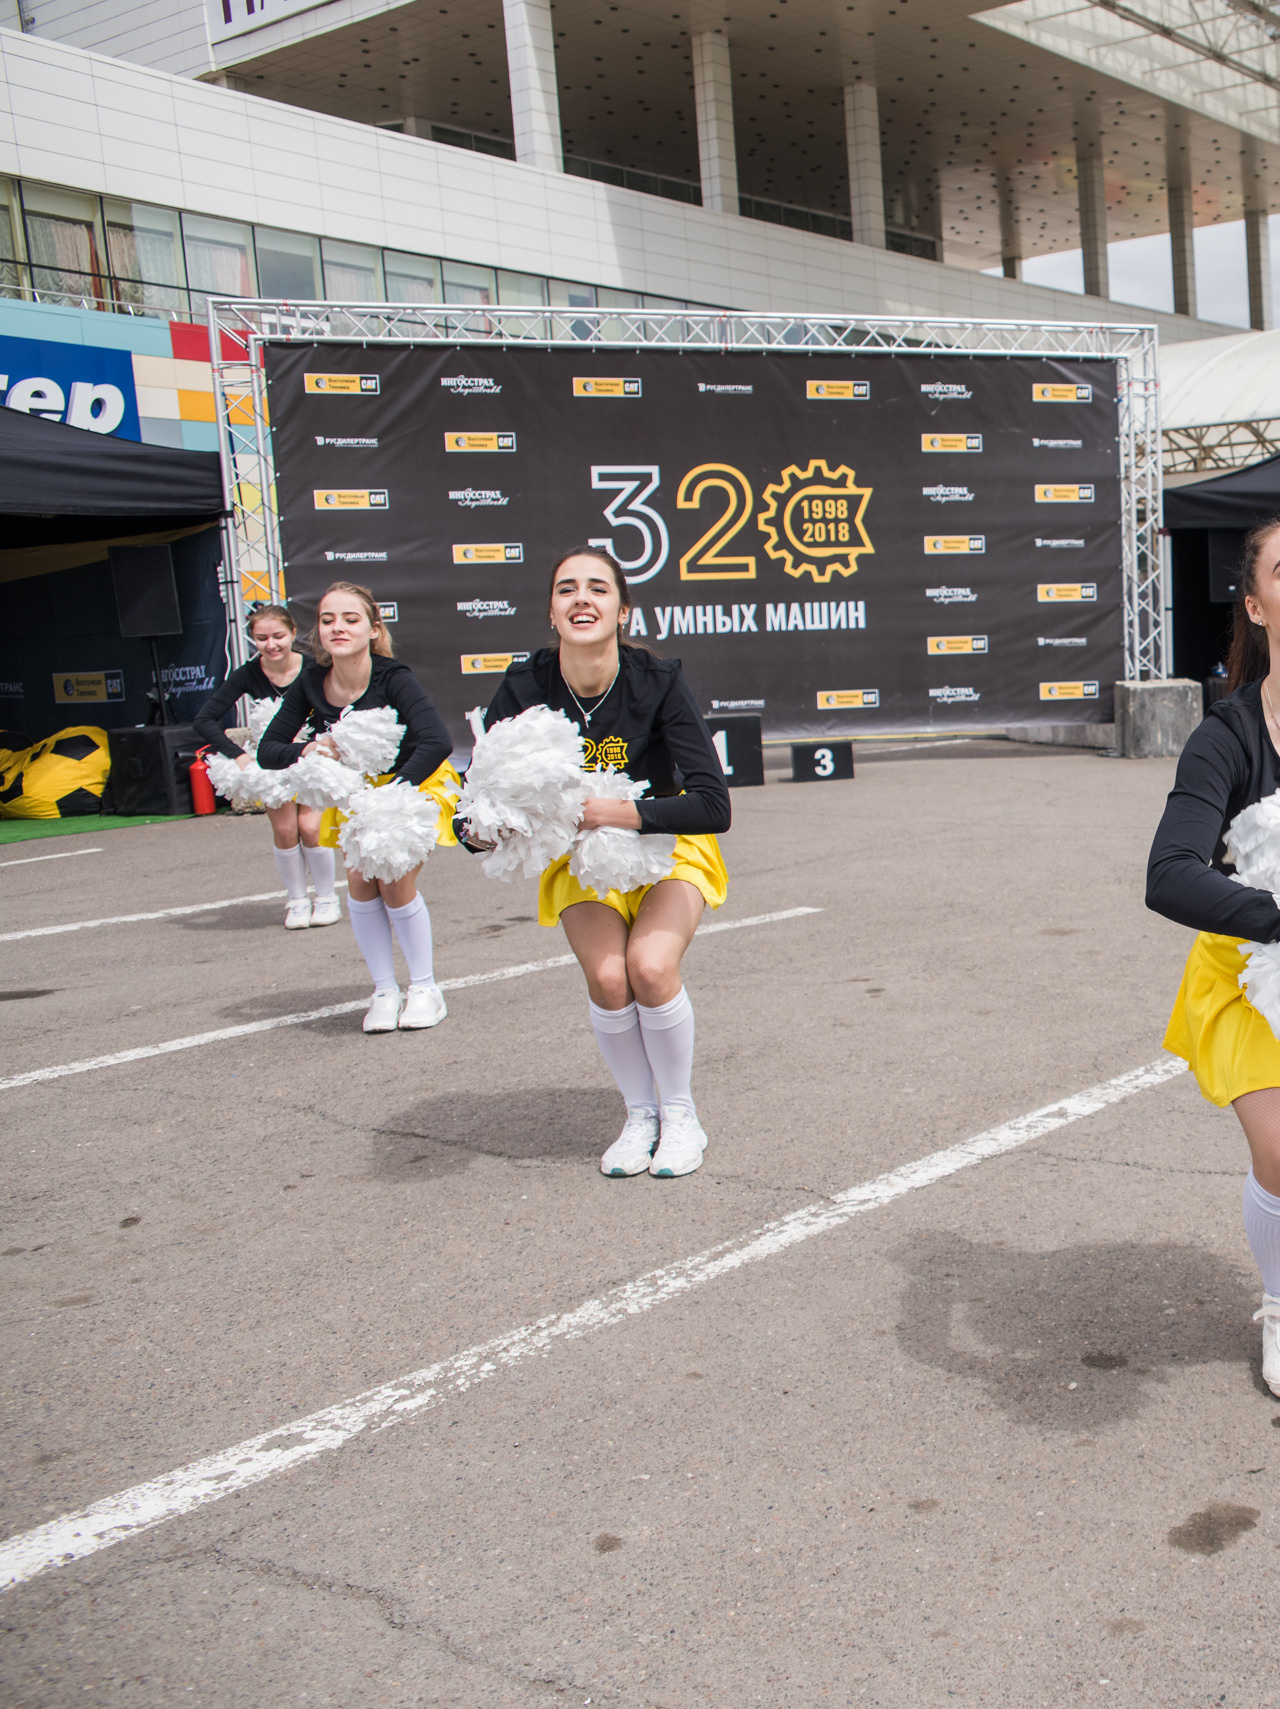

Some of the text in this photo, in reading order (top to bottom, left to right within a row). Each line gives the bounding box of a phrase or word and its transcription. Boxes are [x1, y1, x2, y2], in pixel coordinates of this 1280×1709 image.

[360, 379, 377, 390] CAT
[441, 377, 494, 387] ИНГОССТРАХ
[624, 383, 639, 392] CAT
[498, 438, 514, 447] CAT
[369, 494, 385, 504] CAT
[449, 490, 501, 500] ИНГОССТРАХ
[801, 499, 848, 519] 1998
[803, 522, 849, 542] 2018
[505, 548, 520, 557] CAT
[457, 601, 509, 611] ИНГОССТРАХ
[654, 604, 758, 640] УМНЫХ
[766, 601, 866, 631] МАШИН
[75, 678, 102, 687] Восточная
[106, 678, 121, 693] CAT
[76, 688, 97, 697] Техника
[814, 748, 835, 776] 3
